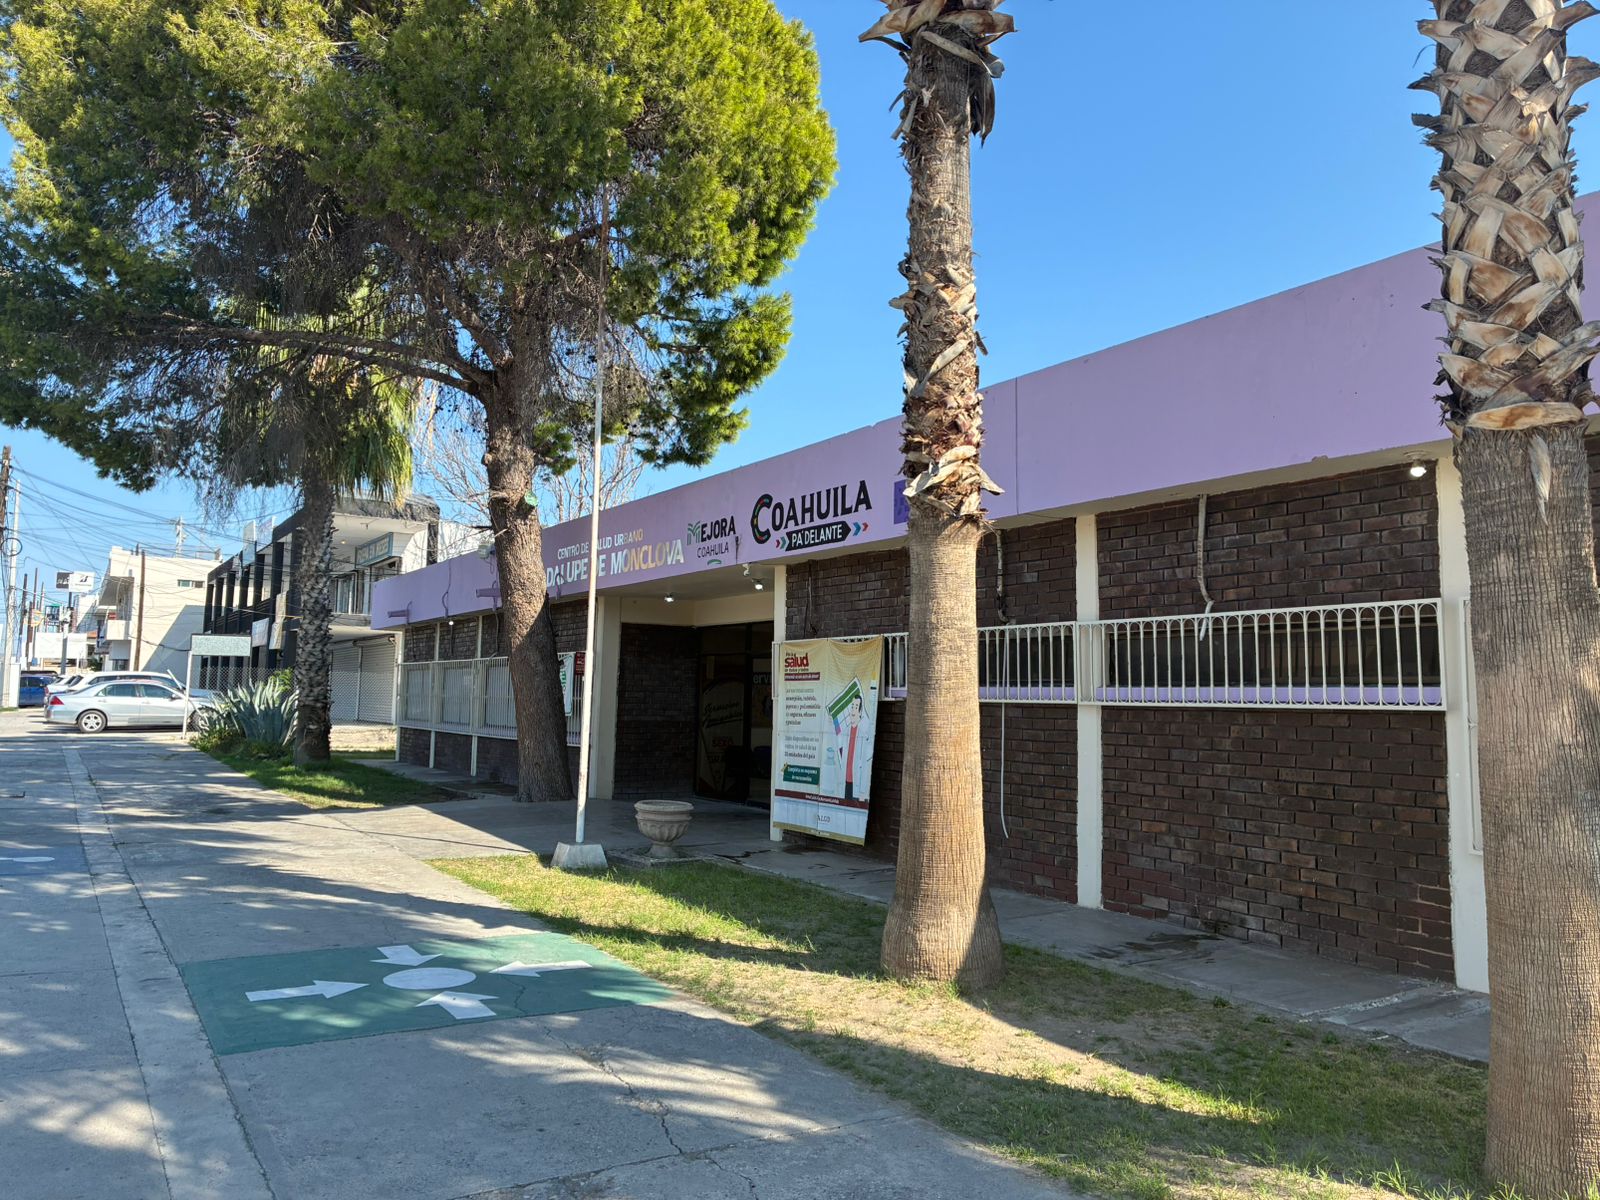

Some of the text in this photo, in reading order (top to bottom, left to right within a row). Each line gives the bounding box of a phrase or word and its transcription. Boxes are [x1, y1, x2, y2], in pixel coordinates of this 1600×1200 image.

[750, 480, 872, 544] COAHUILA
[557, 528, 643, 560] CENTRO DE ALUD URBANO
[610, 538, 684, 576] MONCLOVA
[696, 541, 730, 559] COAHUILA
[784, 652, 809, 668] salud
